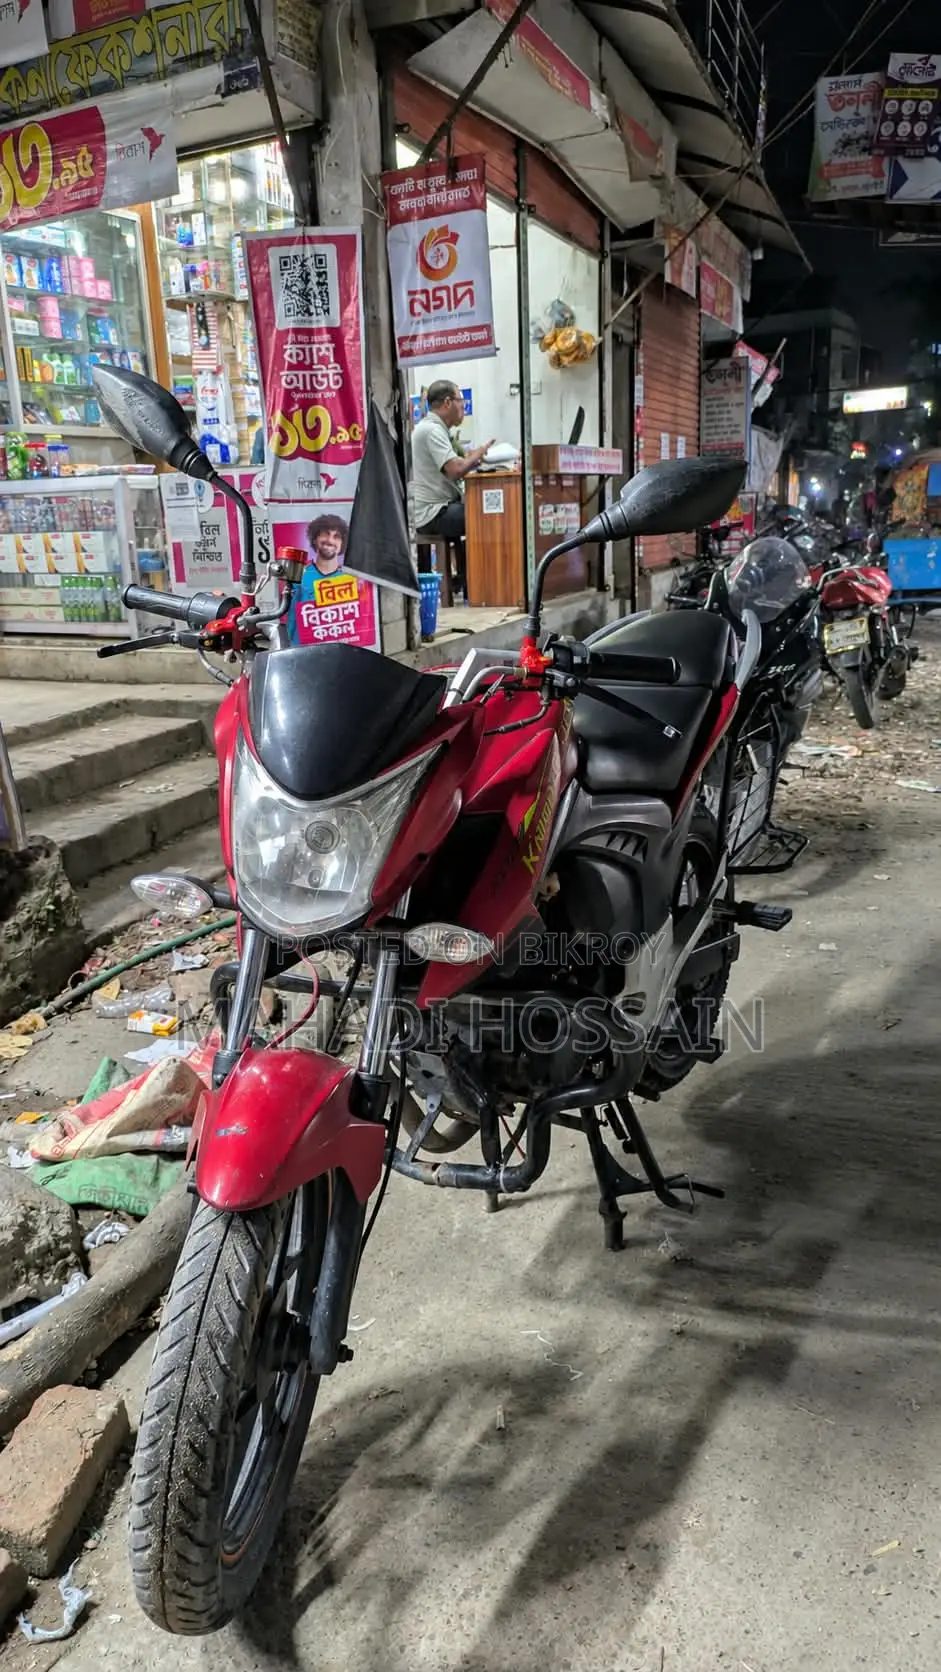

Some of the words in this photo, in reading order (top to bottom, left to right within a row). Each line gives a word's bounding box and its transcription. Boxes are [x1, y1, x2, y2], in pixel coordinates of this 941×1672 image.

[407, 280, 475, 318] নগদ
[283, 342, 336, 366] ক্যাশ
[280, 363, 344, 390] আউট
[318, 579, 355, 603] বিল
[301, 601, 360, 628] বিকাশ
